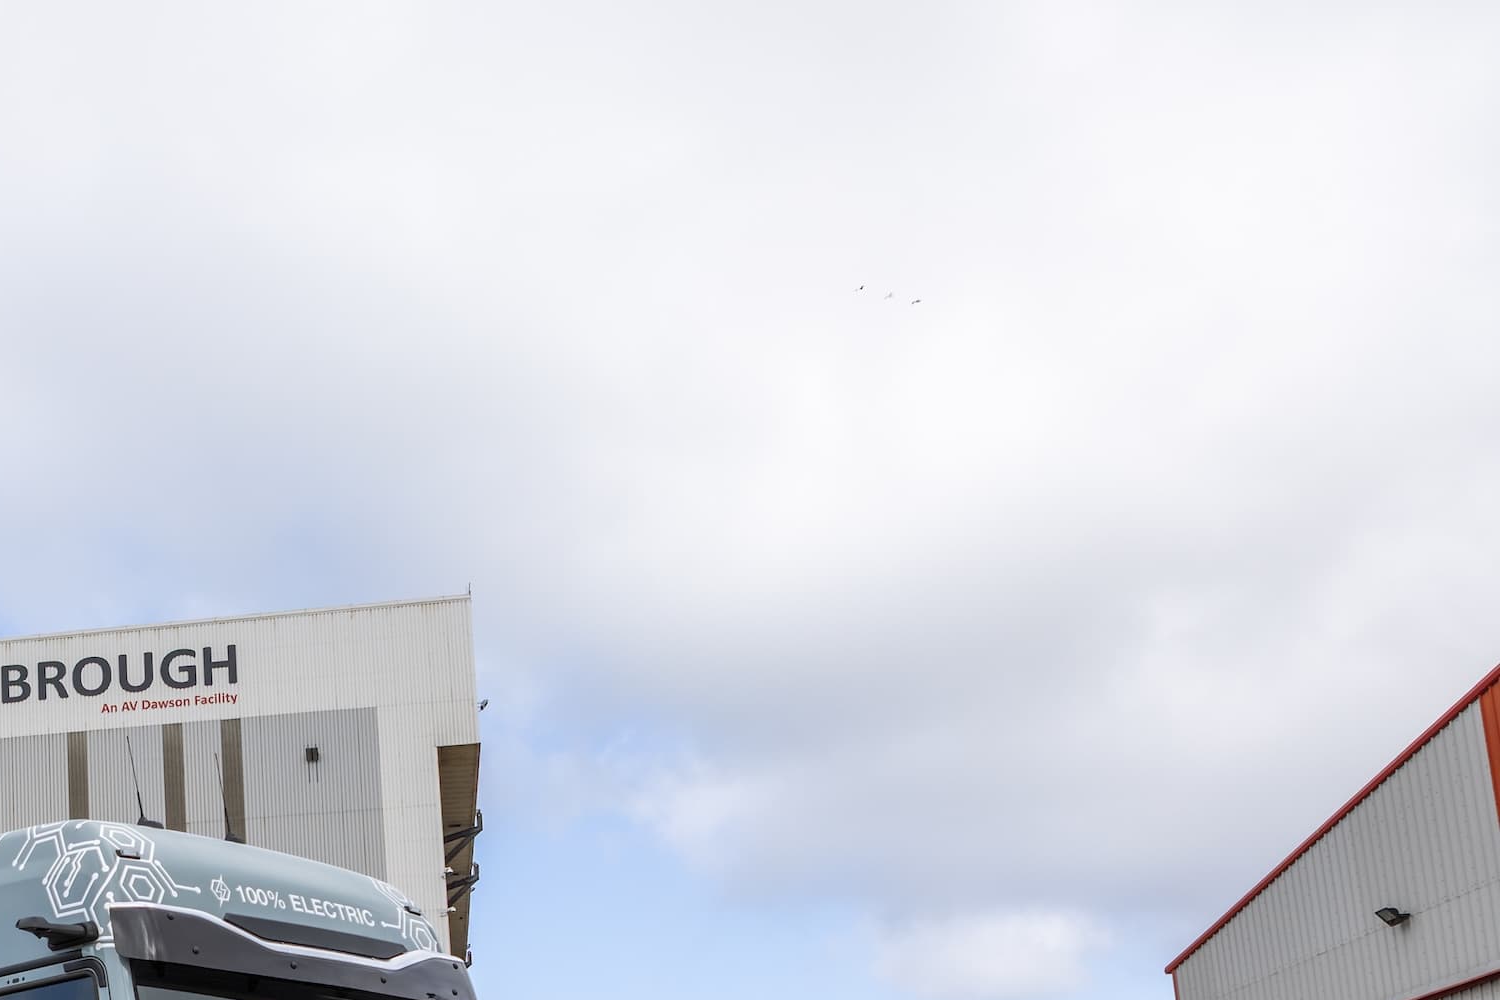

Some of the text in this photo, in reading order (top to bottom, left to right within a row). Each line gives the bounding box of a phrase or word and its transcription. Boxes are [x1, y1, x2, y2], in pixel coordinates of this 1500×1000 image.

[101, 692, 238, 714] An AV Dawson Facility
[235, 884, 376, 927] 100% ELECTRIC
